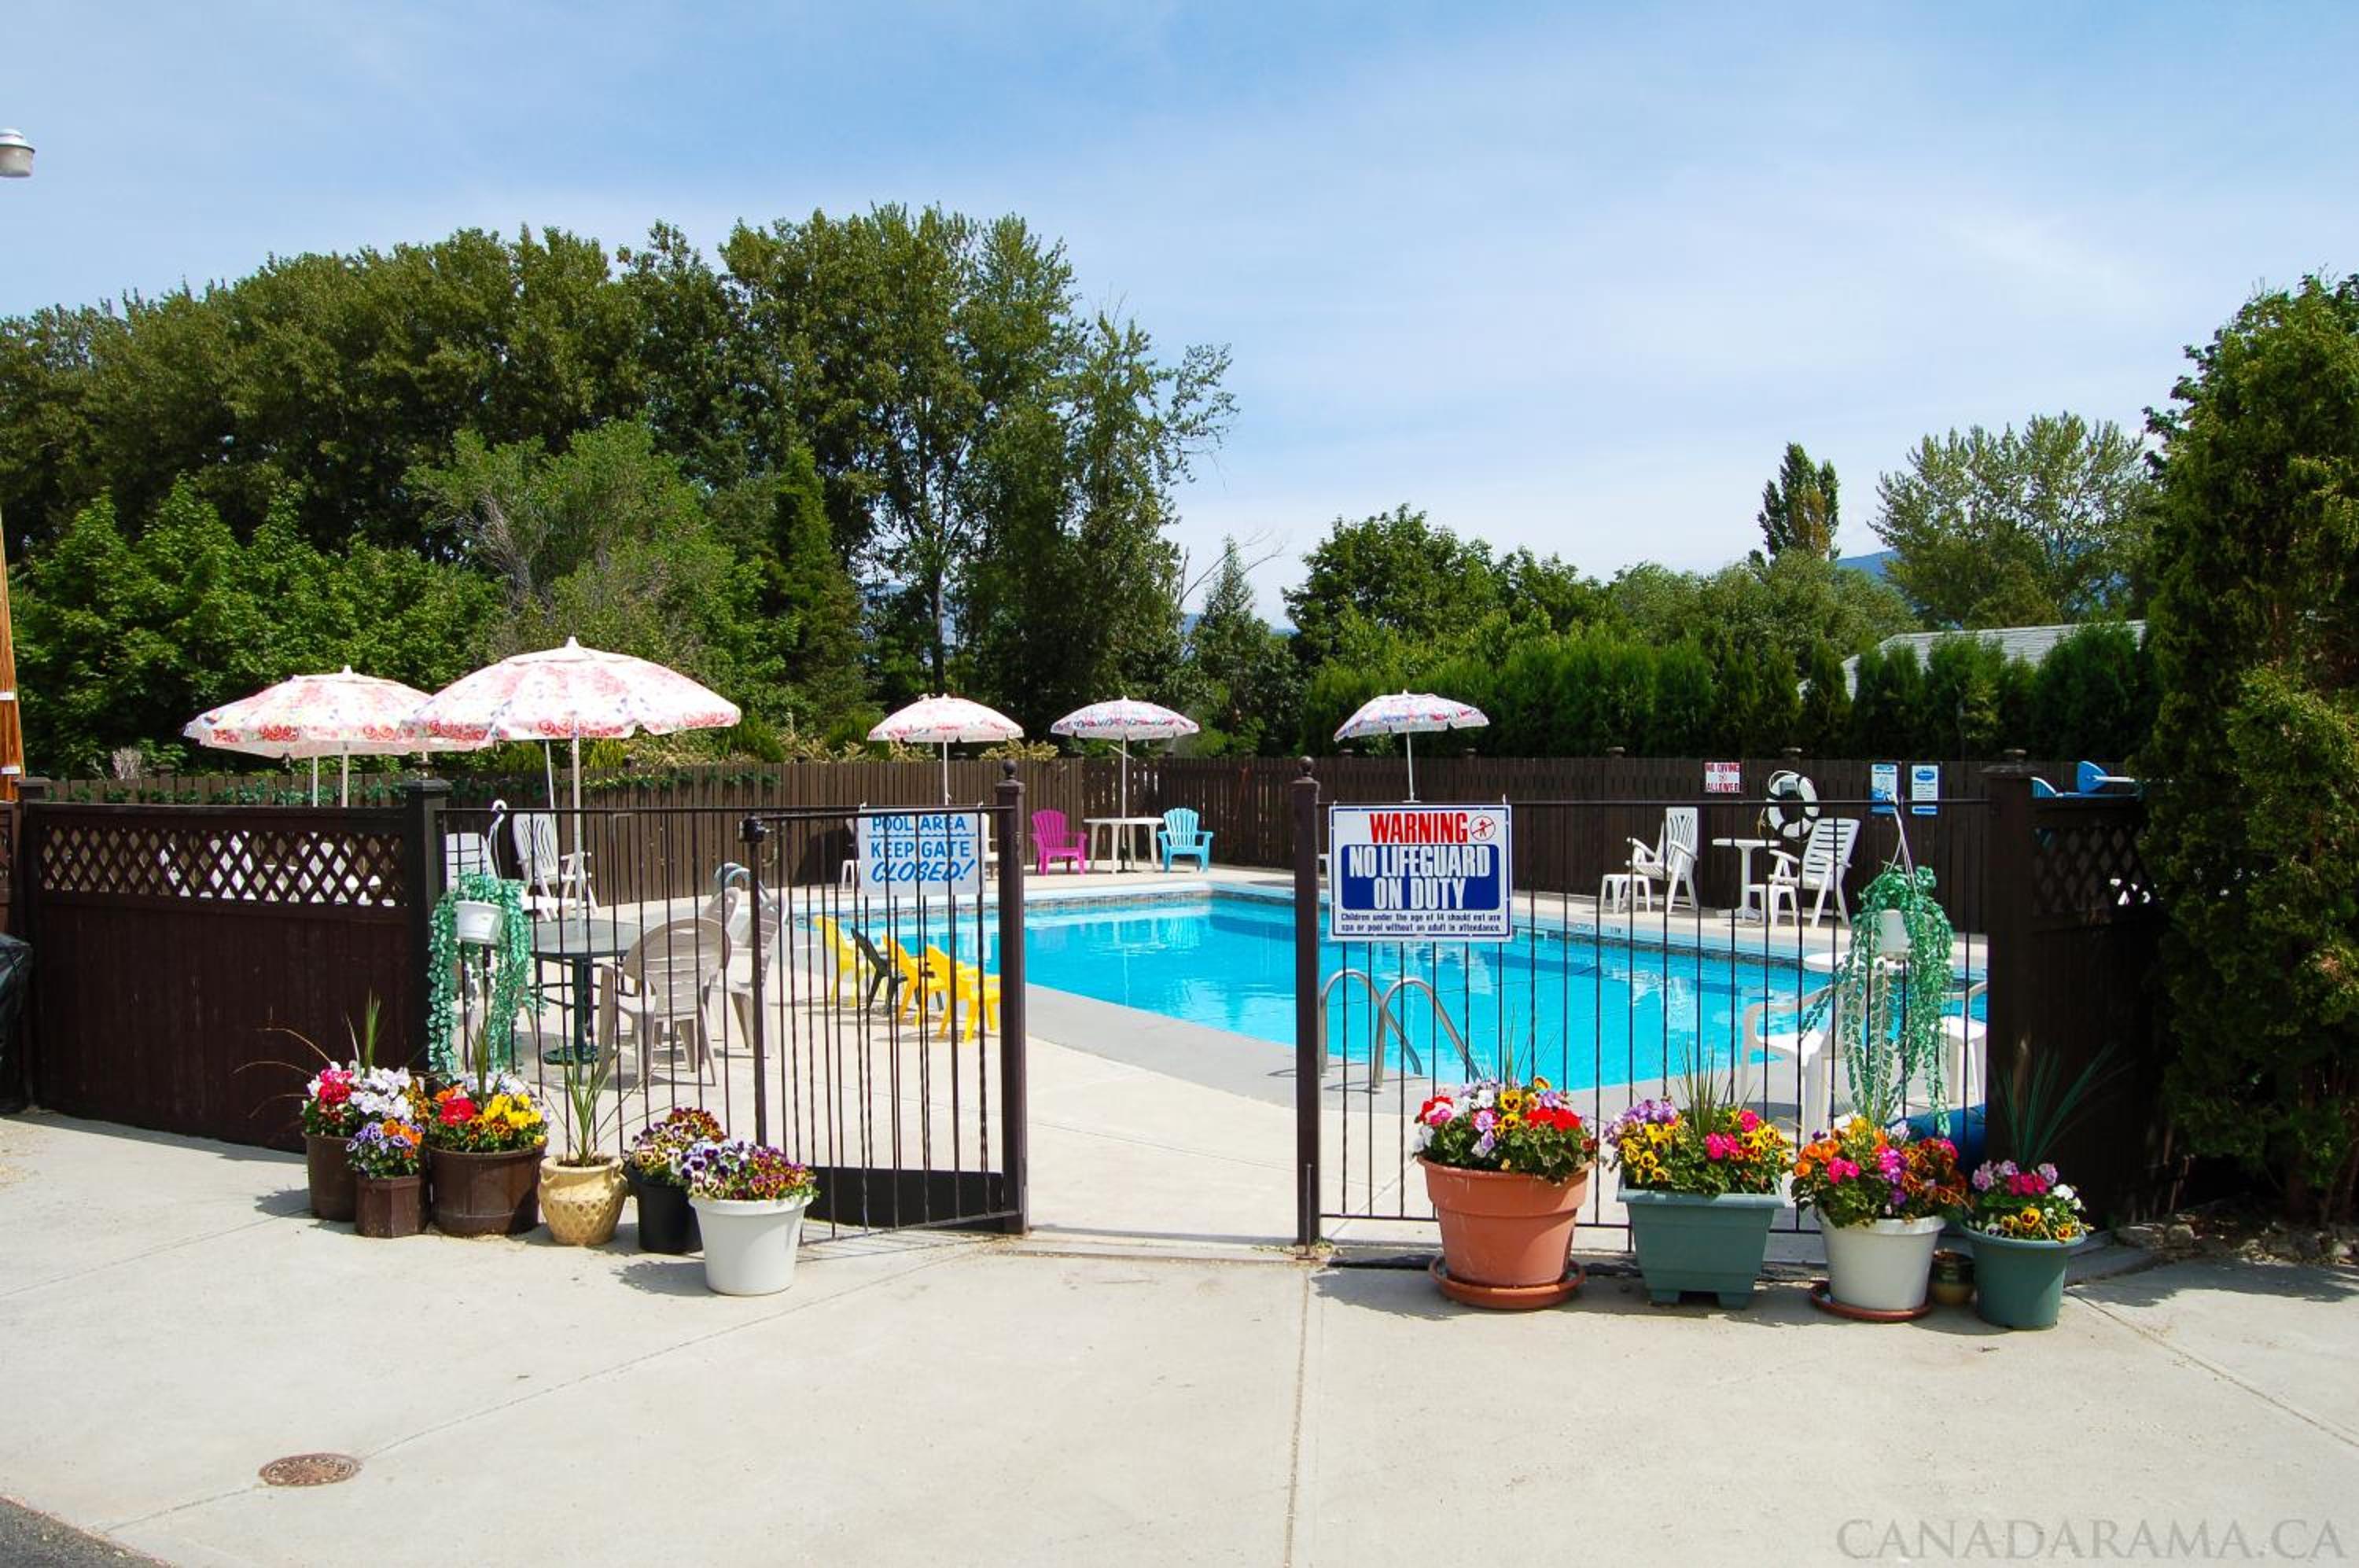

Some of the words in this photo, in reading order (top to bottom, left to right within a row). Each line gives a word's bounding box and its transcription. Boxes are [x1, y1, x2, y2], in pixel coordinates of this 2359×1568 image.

[872, 816, 914, 831] POOL
[920, 815, 966, 831] AREA
[1369, 812, 1469, 844] WARNING
[870, 841, 915, 858] KEEP
[921, 841, 971, 858] GATE
[871, 859, 976, 882] CLOSED!
[1349, 845, 1377, 878] NO
[1381, 845, 1491, 878] LIFEGUARD
[1373, 877, 1404, 910] ON
[1409, 877, 1467, 910] DUTY
[1341, 913, 1370, 922] Children
[1372, 913, 1393, 922] under
[1396, 913, 1408, 922] the
[1410, 913, 1423, 923] age
[1426, 913, 1433, 922] of
[1447, 913, 1470, 922] should
[1473, 913, 1485, 922] not
